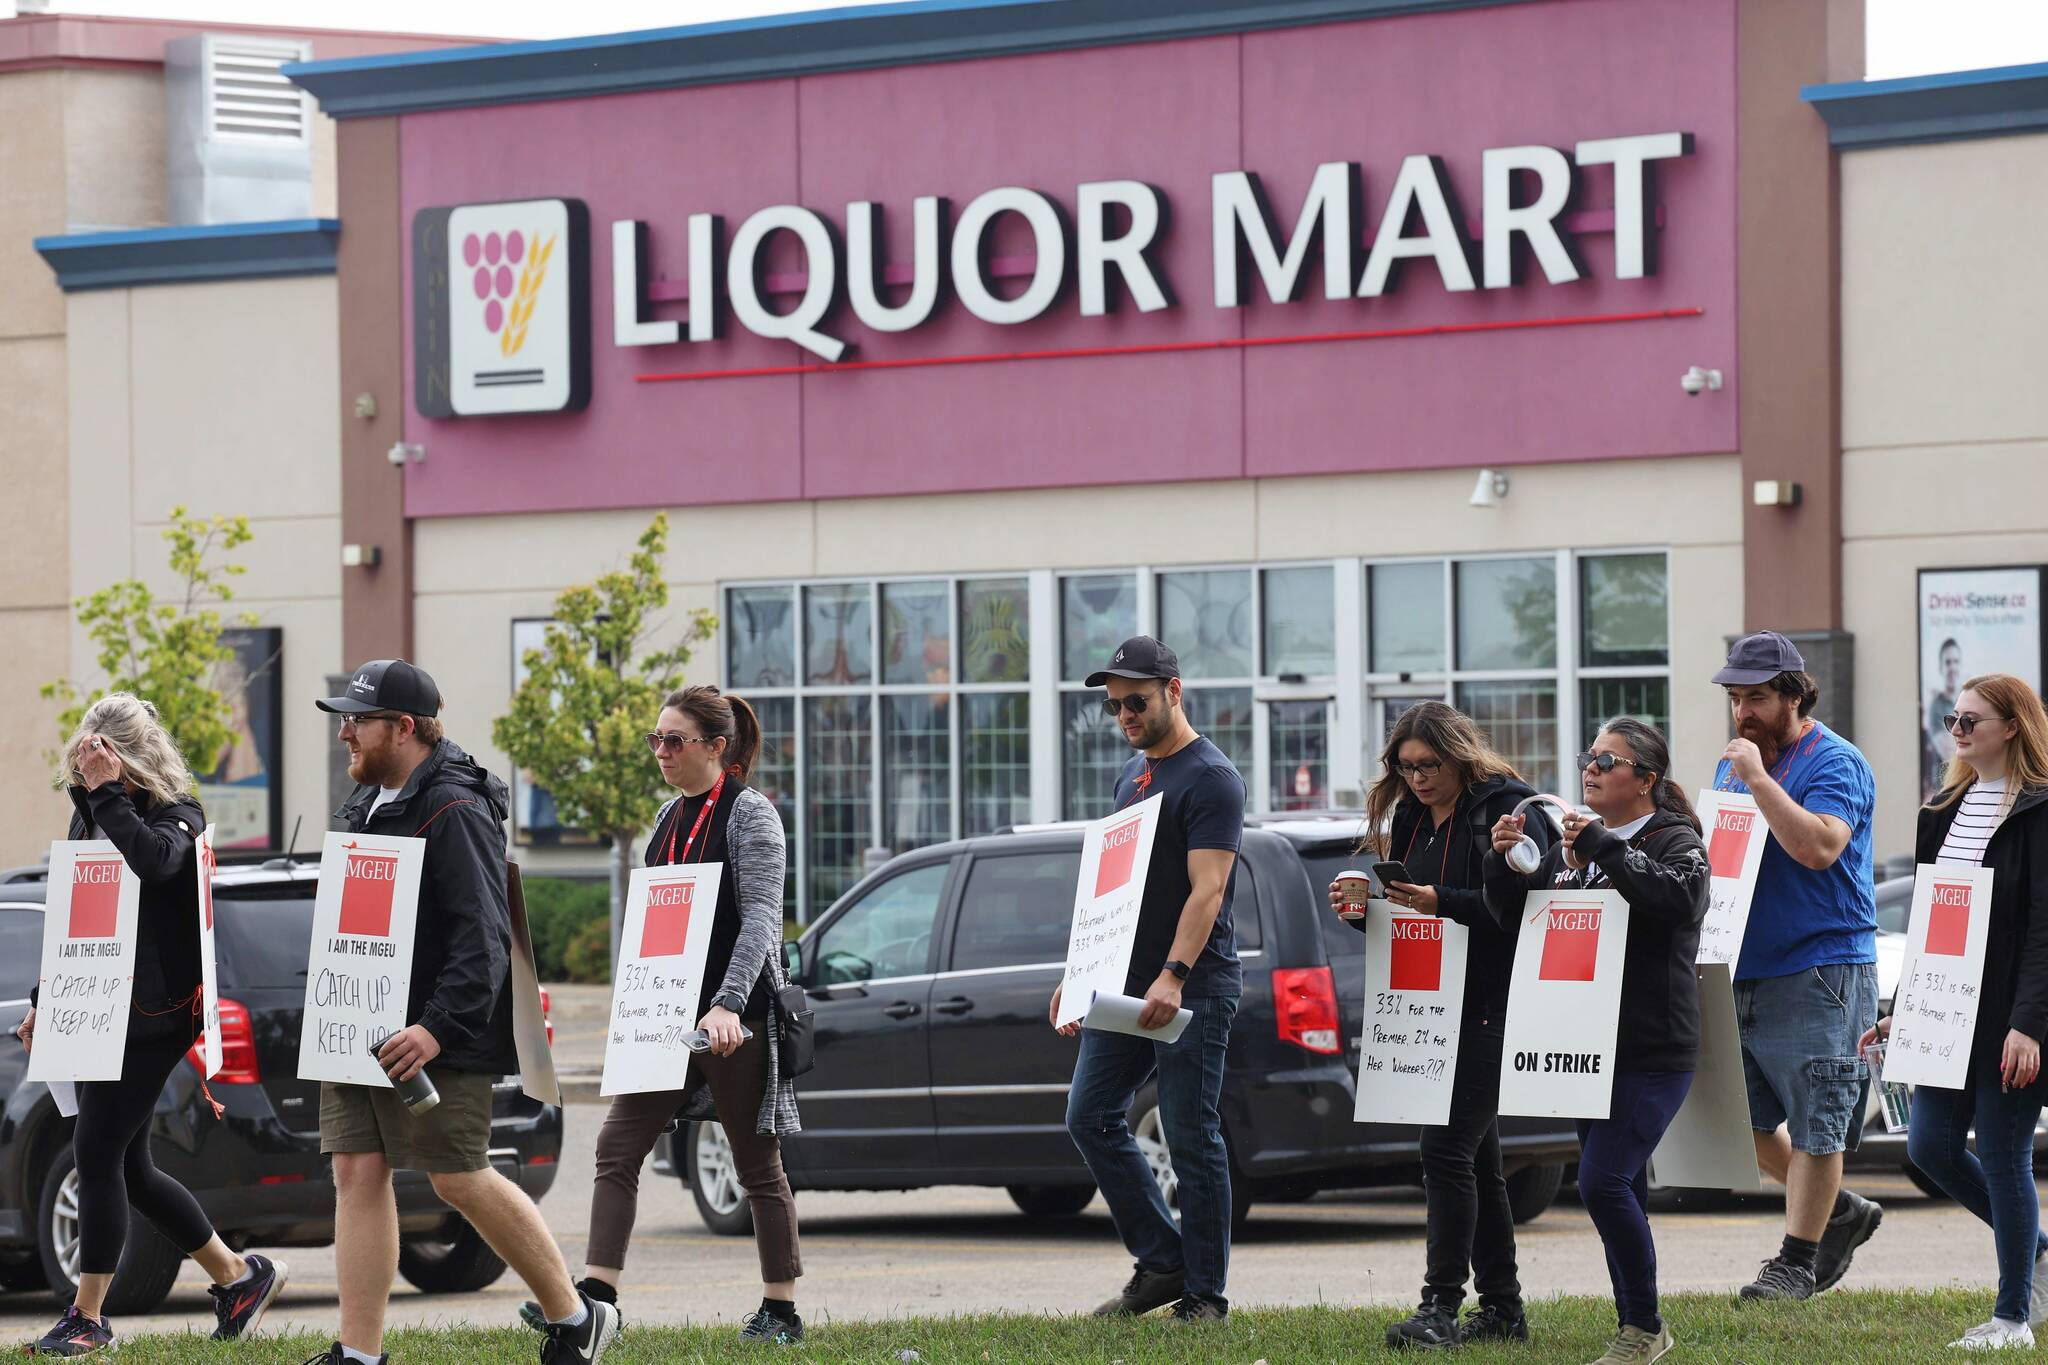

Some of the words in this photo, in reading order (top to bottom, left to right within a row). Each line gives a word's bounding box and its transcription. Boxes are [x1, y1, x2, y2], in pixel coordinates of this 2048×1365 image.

[611, 179, 1172, 364] LIQUOR
[1212, 132, 1688, 309] MART
[1715, 813, 1754, 832] MGEU
[1101, 824, 1141, 852] MGEU
[72, 864, 122, 884] MGEU
[345, 859, 398, 881] MGEU
[647, 886, 695, 907] MGEU
[1931, 887, 1972, 907] MGEU
[1391, 921, 1442, 941] MGEU
[1546, 911, 1602, 931] MGEU
[59, 944, 62, 957] I
[64, 944, 77, 957] AM
[80, 943, 95, 957] THE
[97, 942, 121, 957] MGEU
[328, 938, 332, 952] I
[334, 939, 348, 954] AM
[351, 940, 367, 955] THE
[369, 942, 396, 957] MGEU
[51, 973, 97, 999] CATCH
[103, 978, 120, 998] UP
[315, 967, 360, 1008] CATCH
[367, 975, 391, 1014] UP
[671, 979, 687, 989] THE
[1949, 983, 1957, 993] IS
[50, 1007, 88, 1035] KEEP
[92, 1003, 115, 1035] UP!
[656, 1003, 669, 1017] 2%
[1409, 1004, 1424, 1016] FOR
[1430, 1006, 1445, 1016] THE
[318, 1018, 357, 1056] KEEP
[366, 1026, 390, 1056] UP
[1415, 1029, 1429, 1044] 2%
[1366, 1055, 1383, 1071] HER
[1514, 1051, 1538, 1072] ON
[1544, 1052, 1601, 1074] STRIKE
